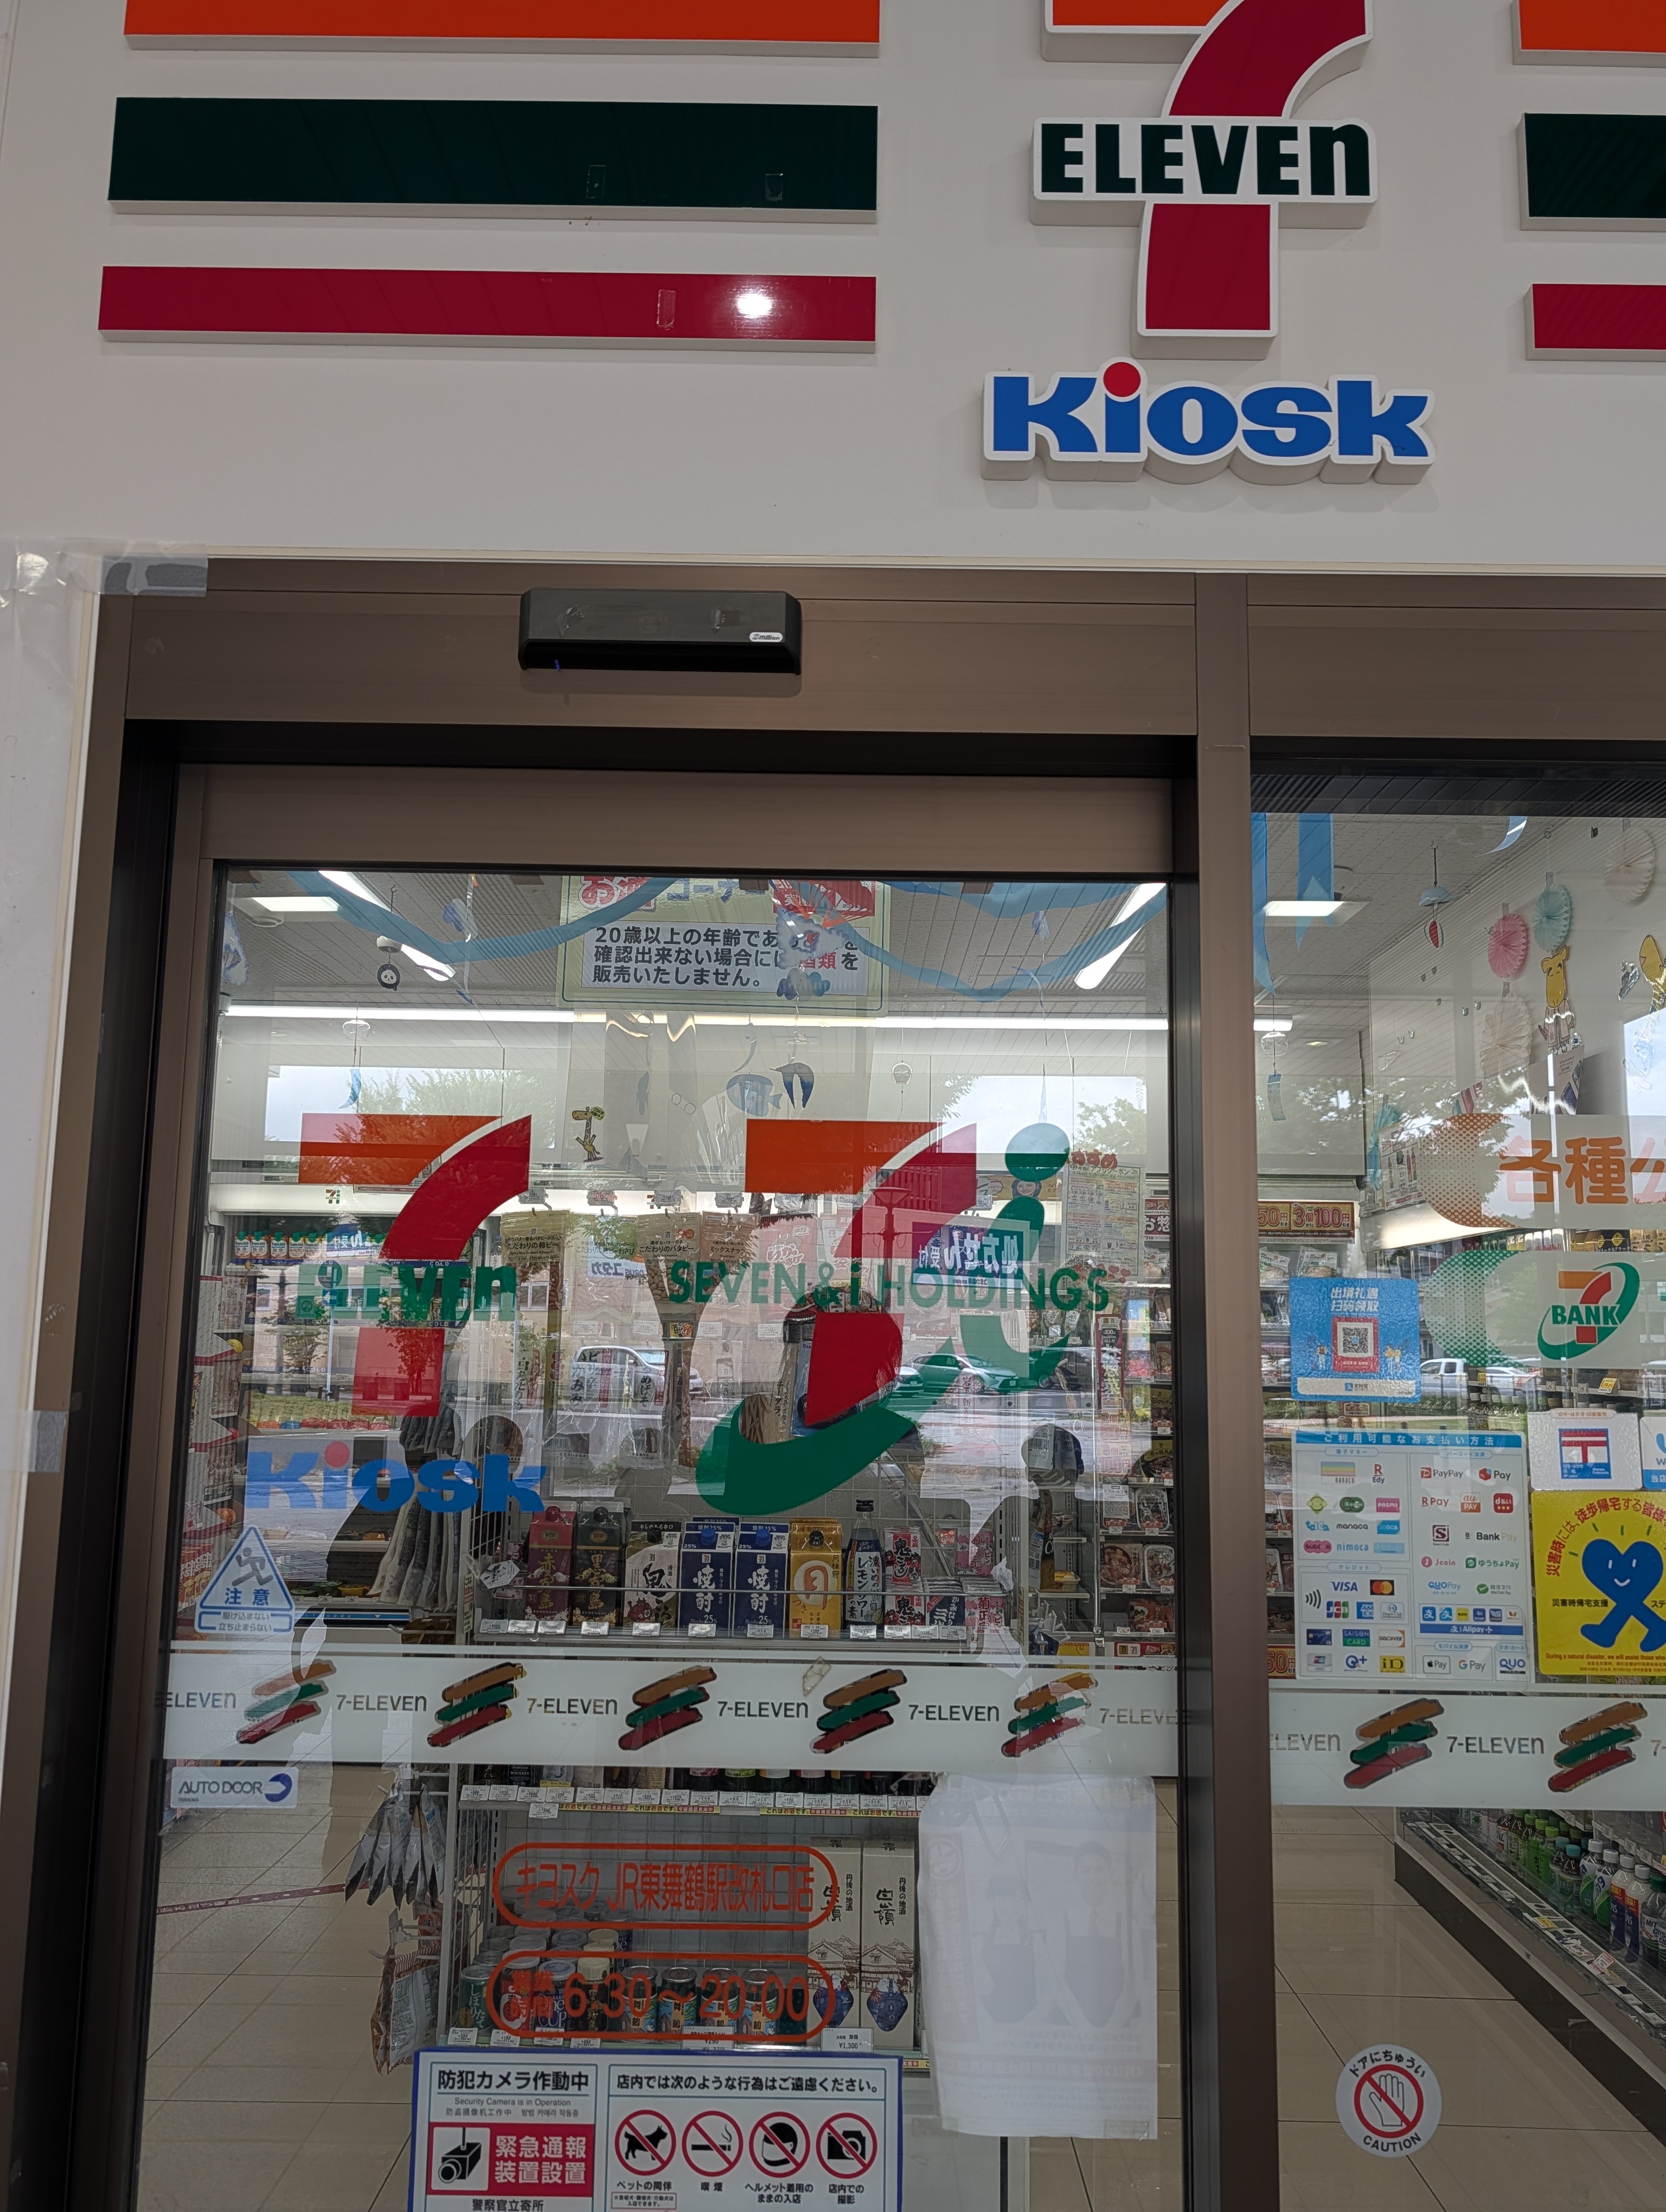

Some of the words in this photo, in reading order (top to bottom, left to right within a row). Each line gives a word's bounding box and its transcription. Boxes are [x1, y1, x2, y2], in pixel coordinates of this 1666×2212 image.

[994, 362, 1428, 457] Kiosk
[593, 965, 760, 987] 販売いたしません。
[1067, 1149, 1118, 1170] すすめ
[877, 1264, 1108, 1311] HOLDINGS
[1552, 1304, 1619, 1326] BANK
[1324, 1433, 1495, 1445] ご利用可能なお支払い方法
[245, 1441, 547, 1512] Kiosk
[1433, 1469, 1463, 1479] PayPay
[1494, 1470, 1511, 1481] Pay
[1430, 1497, 1449, 1507] Pay
[1476, 1532, 1500, 1541] Bank
[1502, 1533, 1517, 1542] Pay
[1546, 1497, 1666, 1577] 災害時には、徒歩帰宅する皆様
[1337, 1542, 1368, 1551] nimoca
[869, 1555, 880, 1587] 濃いめの
[1478, 1559, 1519, 1570] ゆうちょPay
[693, 1564, 715, 1613] 焼酎
[748, 1565, 771, 1613] 焼酎
[1330, 1581, 1358, 1592] VISA
[225, 1587, 270, 1606] 注意
[1552, 1598, 1609, 1608] 災害時帰宅支援
[848, 1600, 857, 1619] の素
[1326, 1603, 1349, 1615] JCB
[222, 1611, 269, 1621] 駆け込まない
[219, 1622, 272, 1632] 立ち止まらない
[1383, 1658, 1404, 1669] iD
[1434, 1660, 1447, 1669] Pay
[1470, 1660, 1486, 1671] Pay
[1500, 1658, 1526, 1670] QUO
[178, 1781, 220, 1794] AUTO
[222, 1781, 262, 1794] DOOR
[516, 1861, 599, 1910] キヨスク
[606, 1862, 815, 1912] JR東舞鶴駅改札口店
[845, 1874, 853, 1912] 丹後の地酒
[898, 1877, 907, 1915] 丹後の地酒
[469, 1984, 485, 2028] しぼりたて
[1349, 2050, 1426, 2078] ドアにちゅうい
[438, 2069, 589, 2091] 防犯カメラ作動中
[617, 2074, 877, 2094] 店内では次のような行為はご遠慮ください。
[454, 2097, 484, 2106] Security
[486, 2098, 516, 2106] Camera
[535, 2098, 571, 2107] Operation
[495, 2135, 587, 2159] 緊急通報
[1363, 2132, 1421, 2152] CAUTION
[494, 2161, 586, 2185] 装置設置
[617, 2180, 672, 2192] ペットの同伴
[701, 2181, 723, 2192] 喫煙
[745, 2182, 813, 2194] ヘルメット着用の
[828, 2184, 864, 2194] 店内での
[472, 2198, 544, 2212] 警察官立寄所
[757, 2194, 802, 2205] ままの入店
[837, 2194, 856, 2205] 撮影
